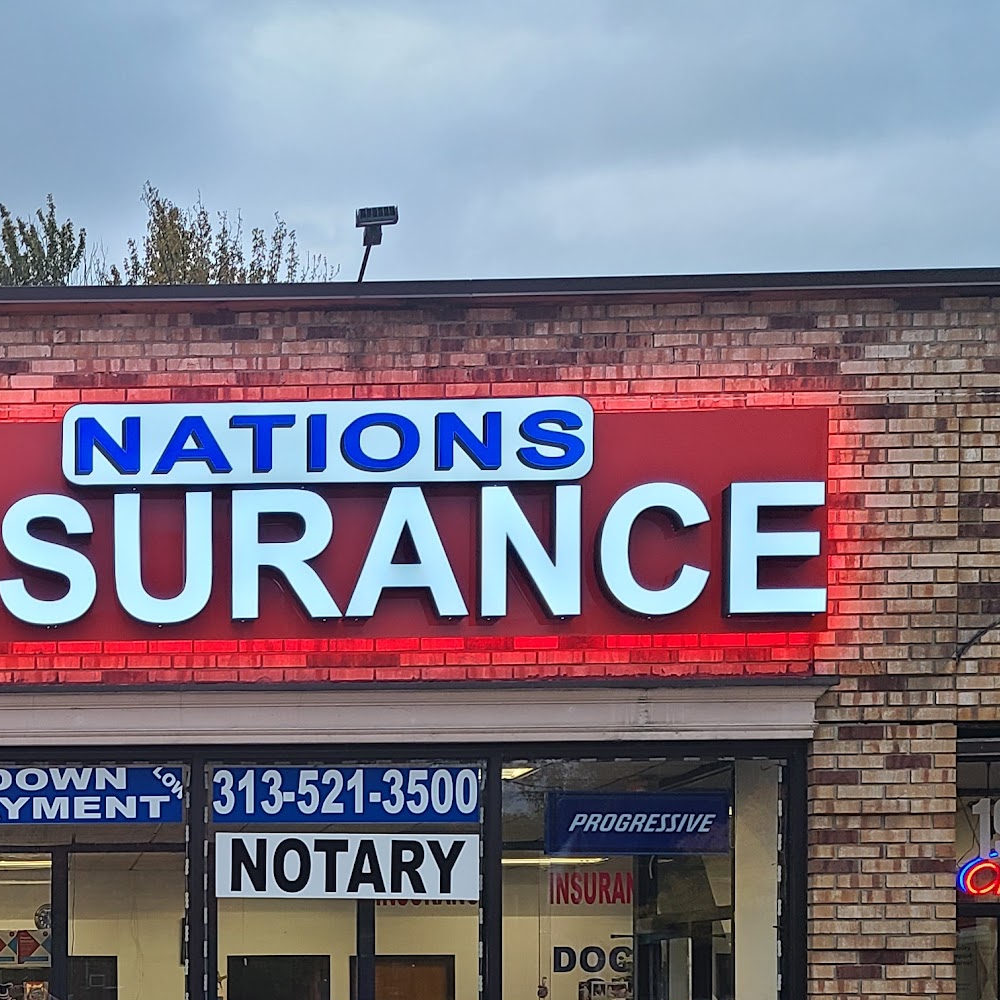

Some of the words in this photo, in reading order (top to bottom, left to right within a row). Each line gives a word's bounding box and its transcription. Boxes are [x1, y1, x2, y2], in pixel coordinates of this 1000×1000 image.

[74, 409, 587, 475] NATIONS
[213, 769, 478, 814] 313-521-3500
[568, 813, 717, 833] PROGRESSIVE
[230, 837, 466, 894] NOTARY
